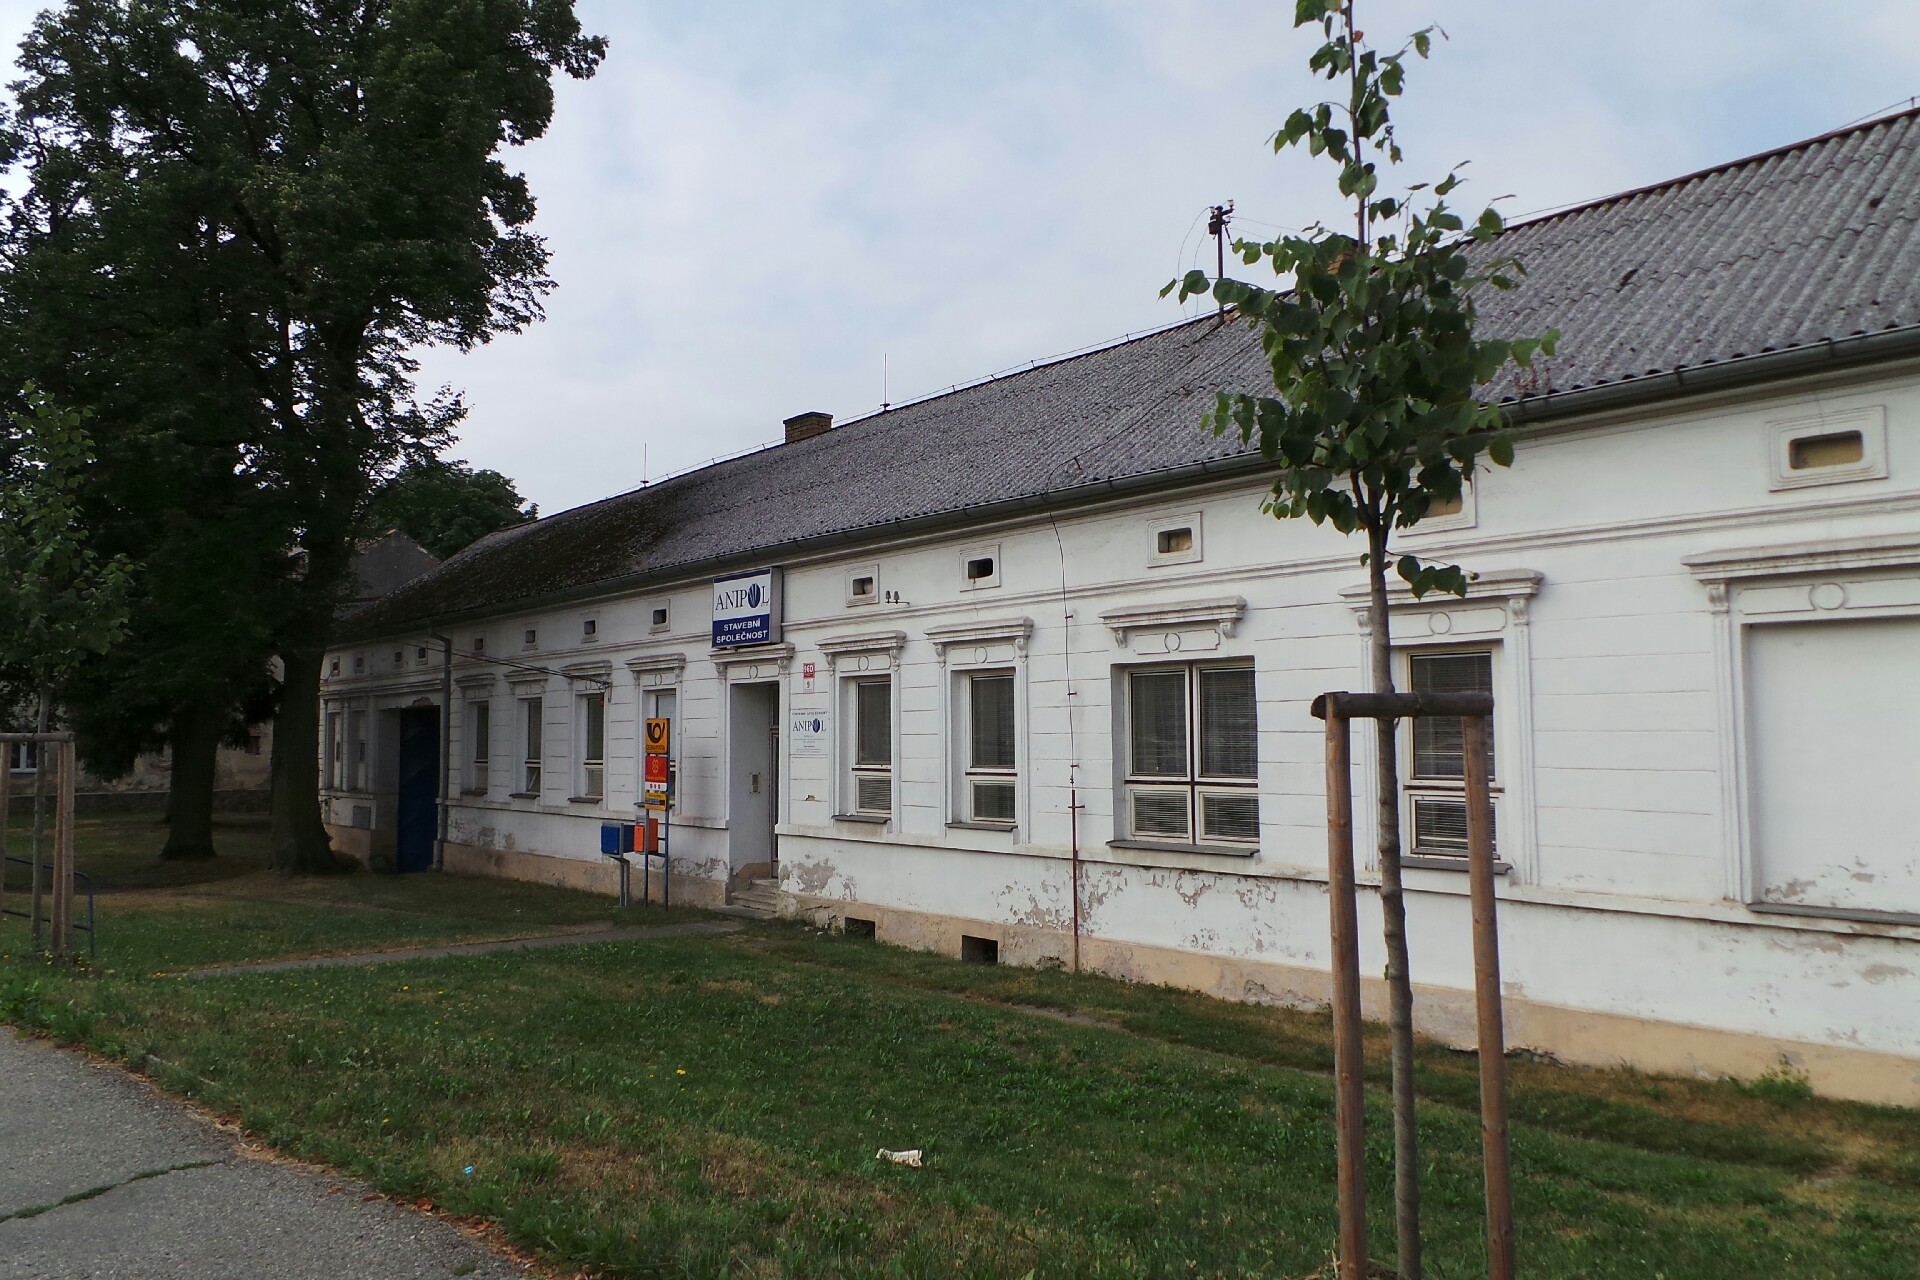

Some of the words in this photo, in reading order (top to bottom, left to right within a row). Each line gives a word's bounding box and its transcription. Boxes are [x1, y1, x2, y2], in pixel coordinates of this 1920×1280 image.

[715, 583, 769, 610] ANIPOL
[723, 618, 760, 631] STAVEBNÍ
[716, 630, 768, 643] SPOLEČNOST
[792, 718, 827, 733] ANIPOL
